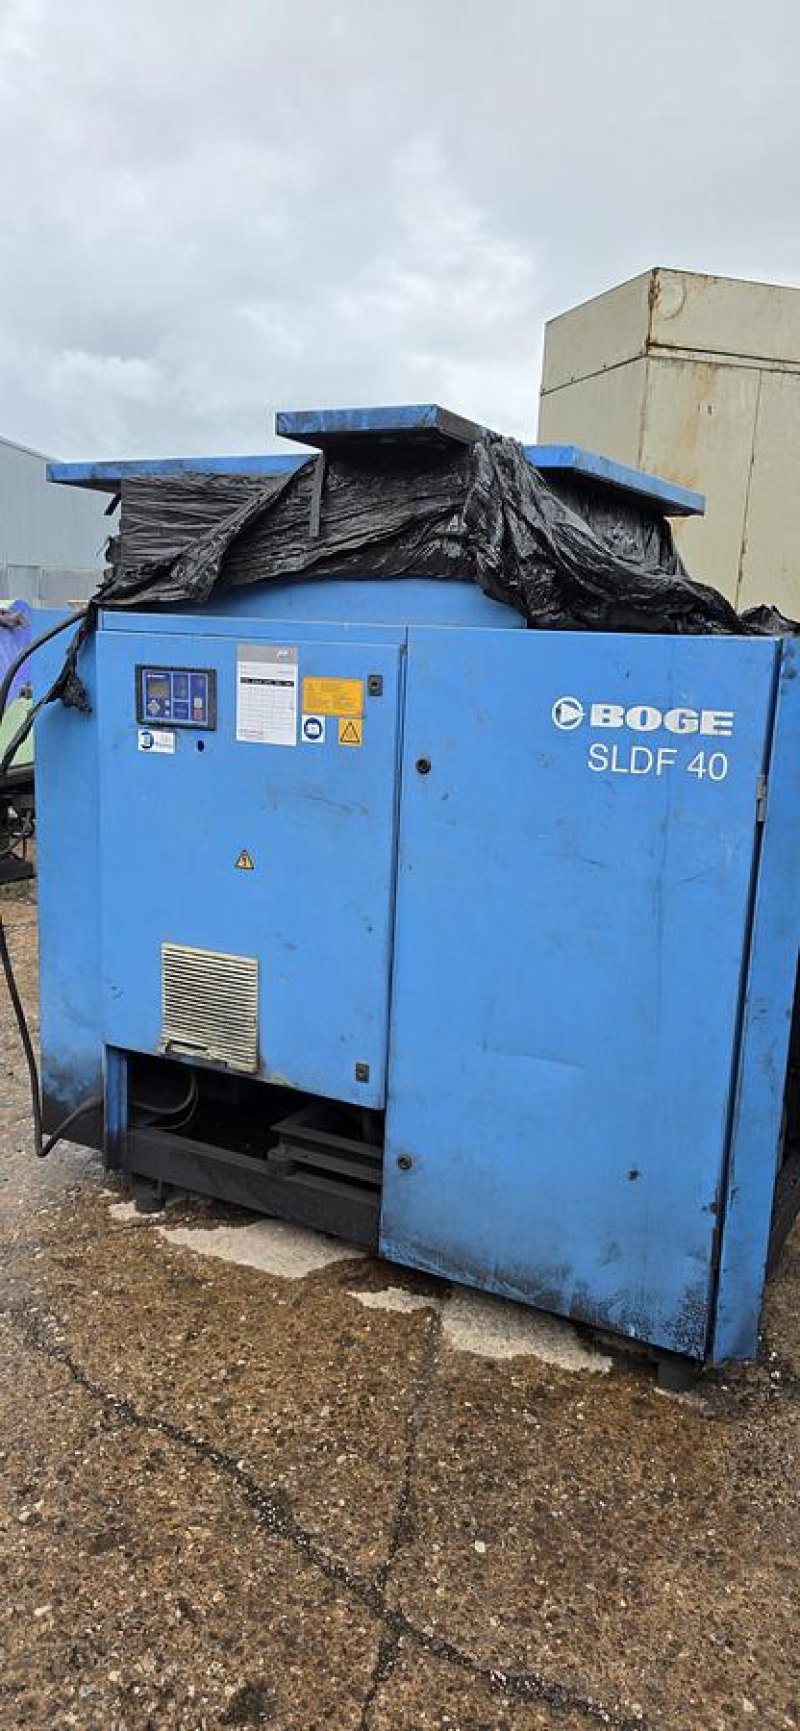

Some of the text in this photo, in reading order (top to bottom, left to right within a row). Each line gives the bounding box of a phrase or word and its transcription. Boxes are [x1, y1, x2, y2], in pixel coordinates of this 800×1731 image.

[590, 703, 734, 736] BOGE
[588, 743, 728, 781] SLDF 40
